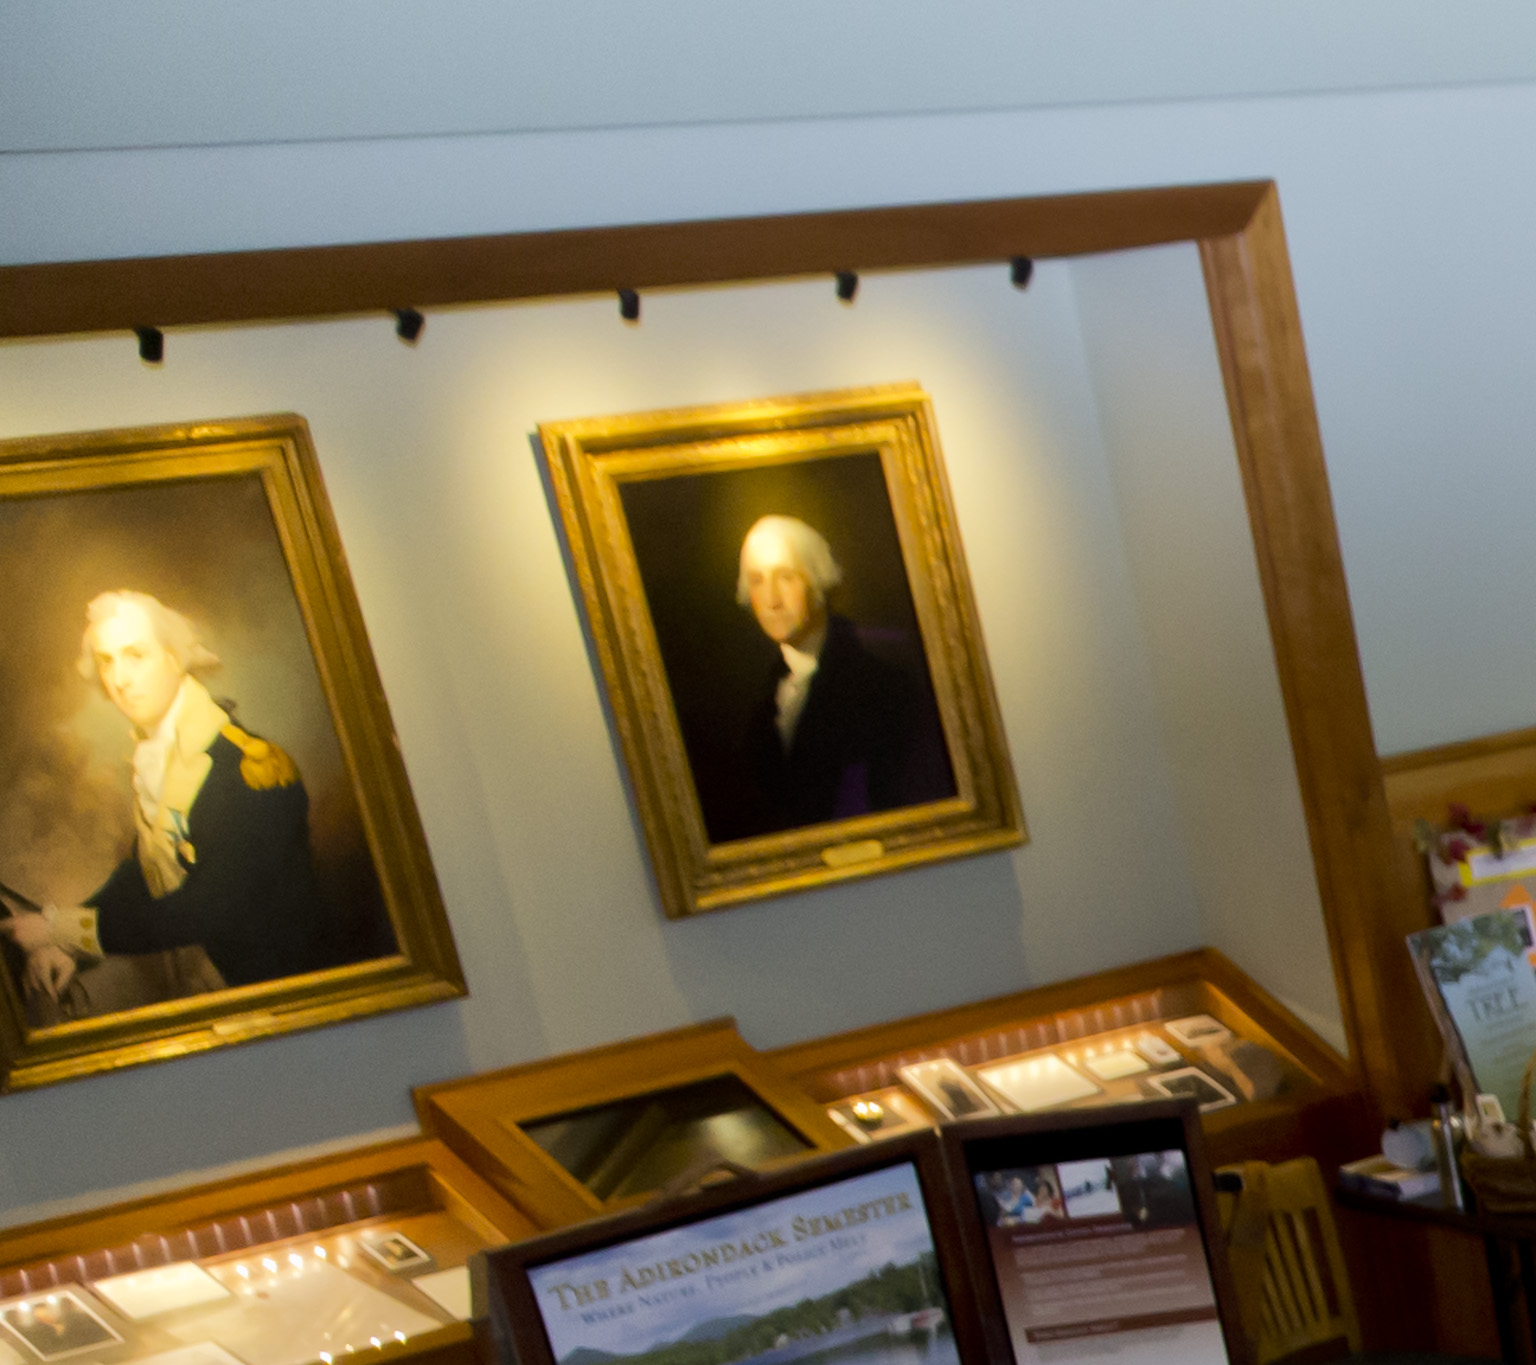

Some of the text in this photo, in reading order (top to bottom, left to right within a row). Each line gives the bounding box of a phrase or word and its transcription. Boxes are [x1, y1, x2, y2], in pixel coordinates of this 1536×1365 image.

[548, 1191, 914, 1311] THE ADIRONDACK SEMESTER
